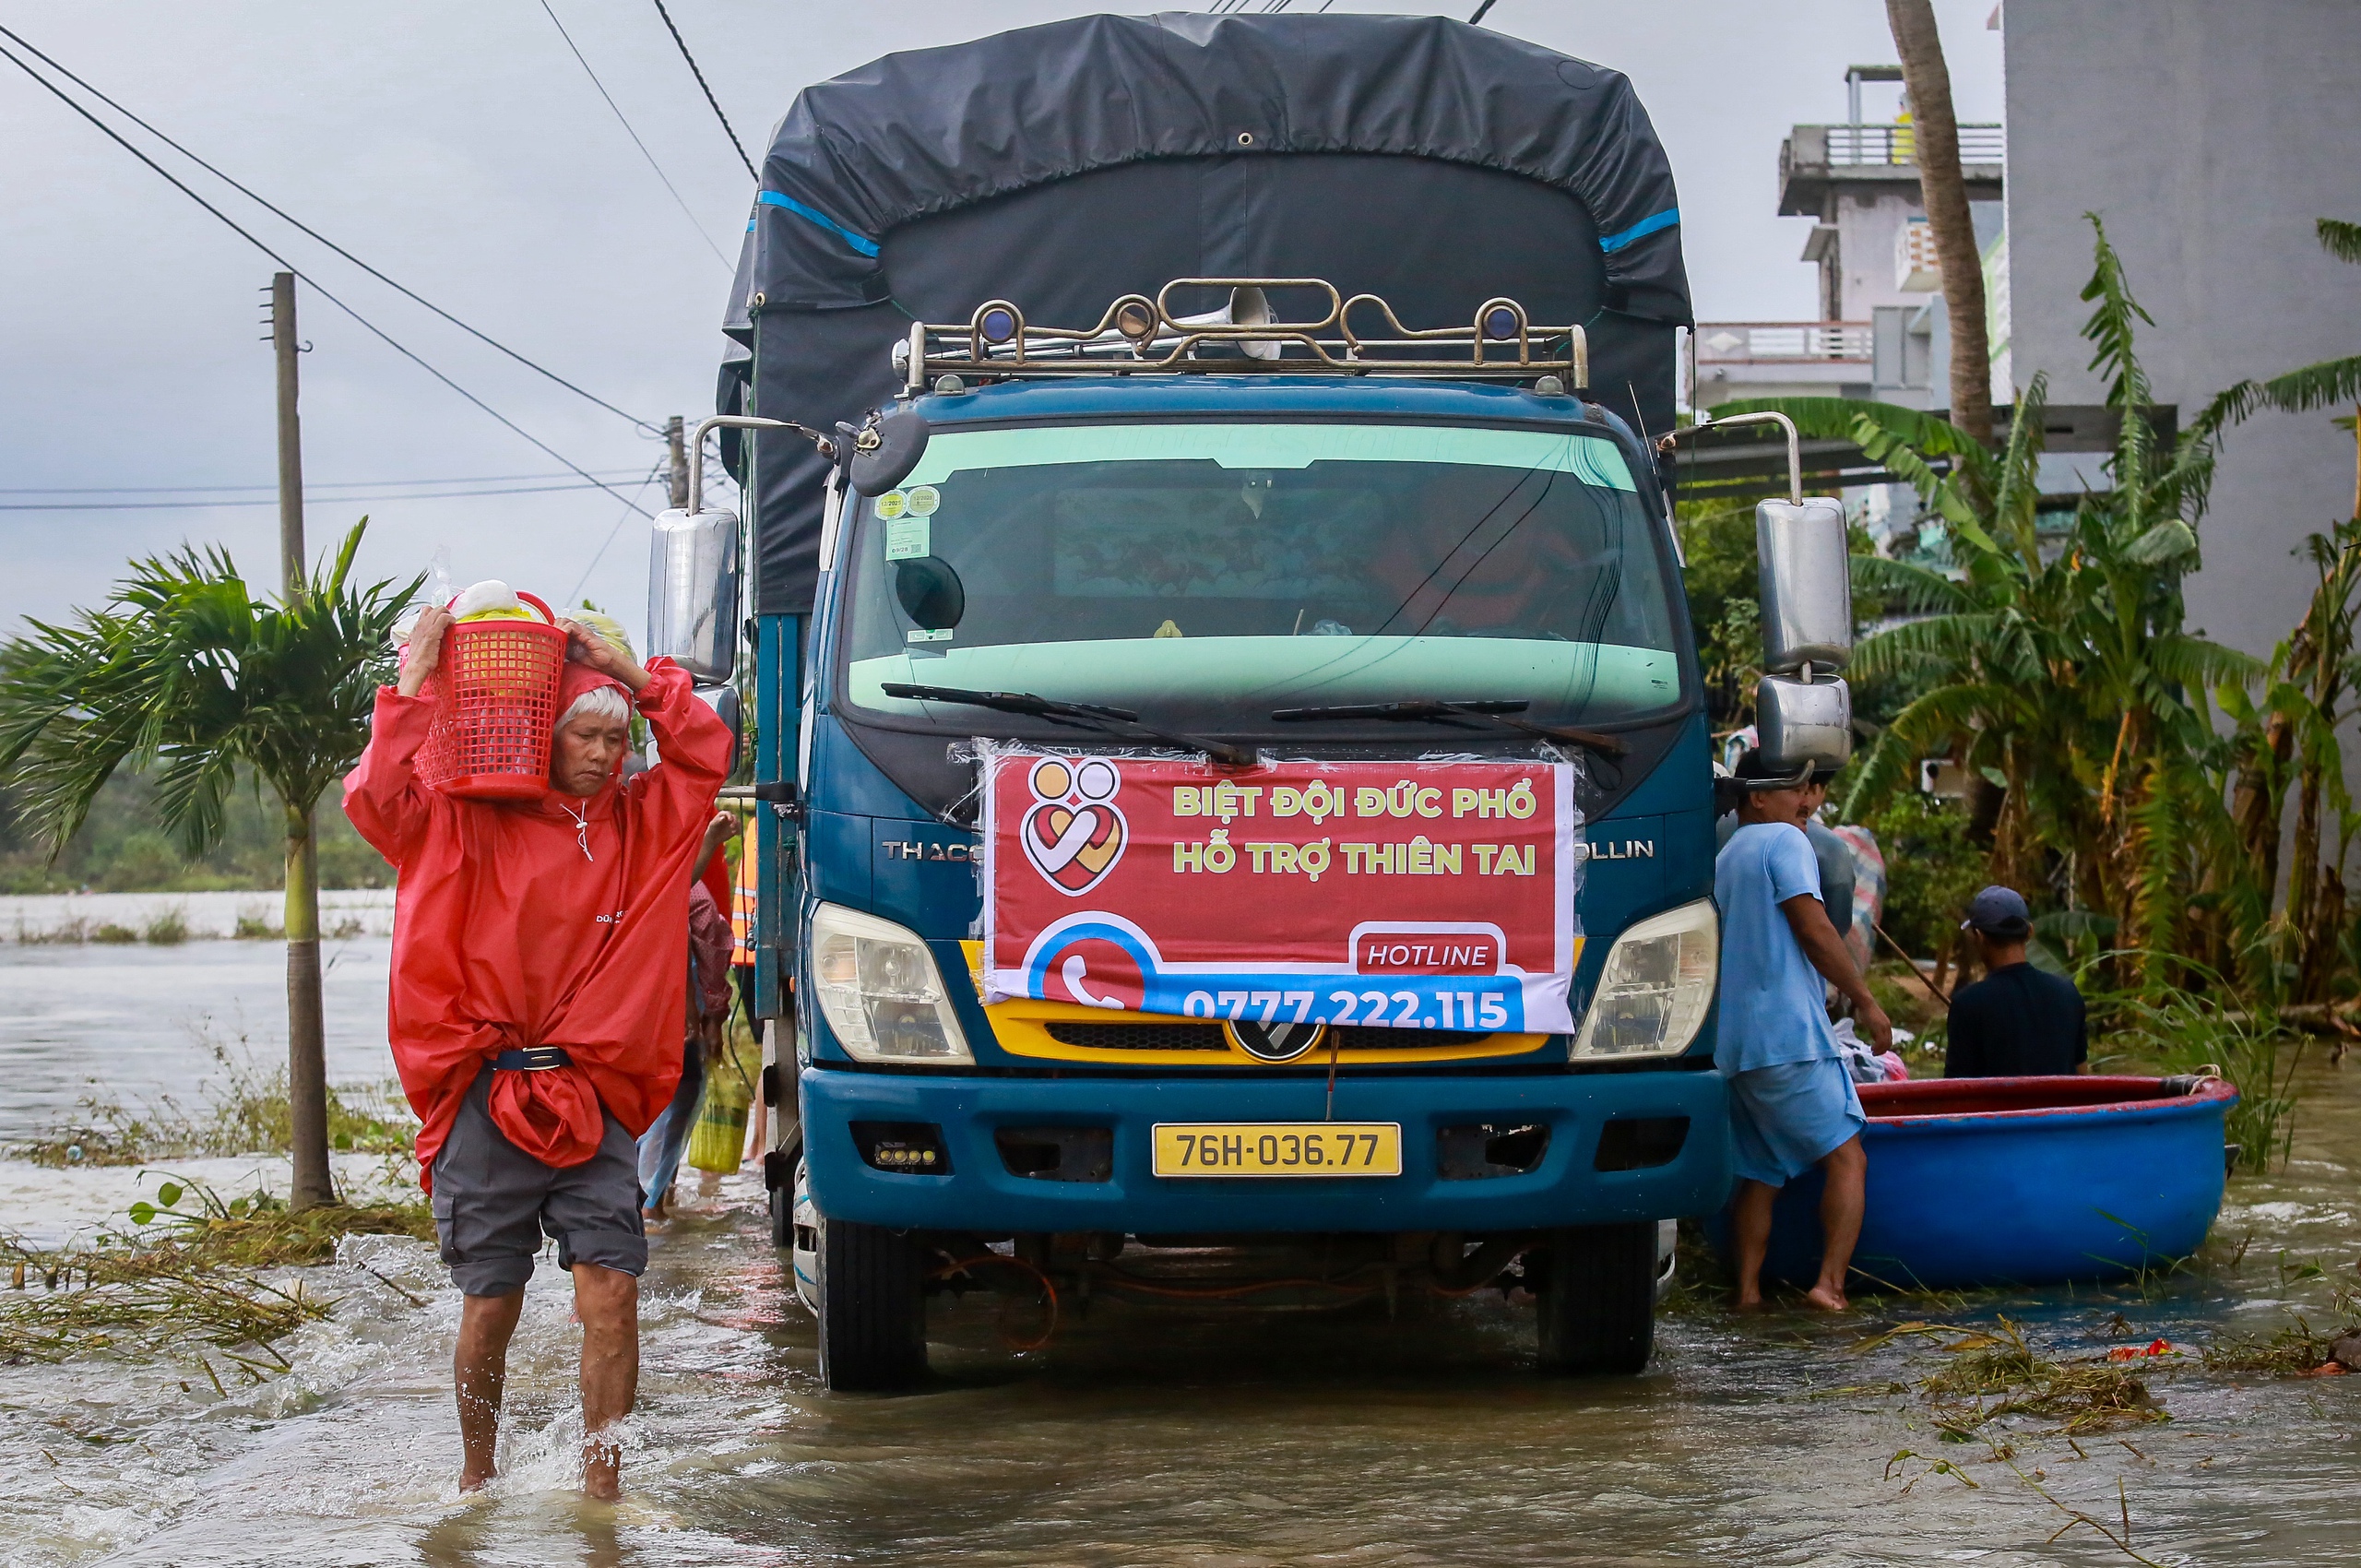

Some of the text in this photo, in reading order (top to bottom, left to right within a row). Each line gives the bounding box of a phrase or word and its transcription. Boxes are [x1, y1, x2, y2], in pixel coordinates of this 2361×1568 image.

[1173, 778, 1536, 826] BIỆT ĐỘI ĐỨC PHỔ
[1173, 828, 1536, 882] HỖ TRỢ THIÊN TAI
[1367, 945, 1489, 967] HOTLINE
[1183, 991, 1508, 1028] 0777.222.115
[1177, 1134, 1378, 1166] 76H-036.77
